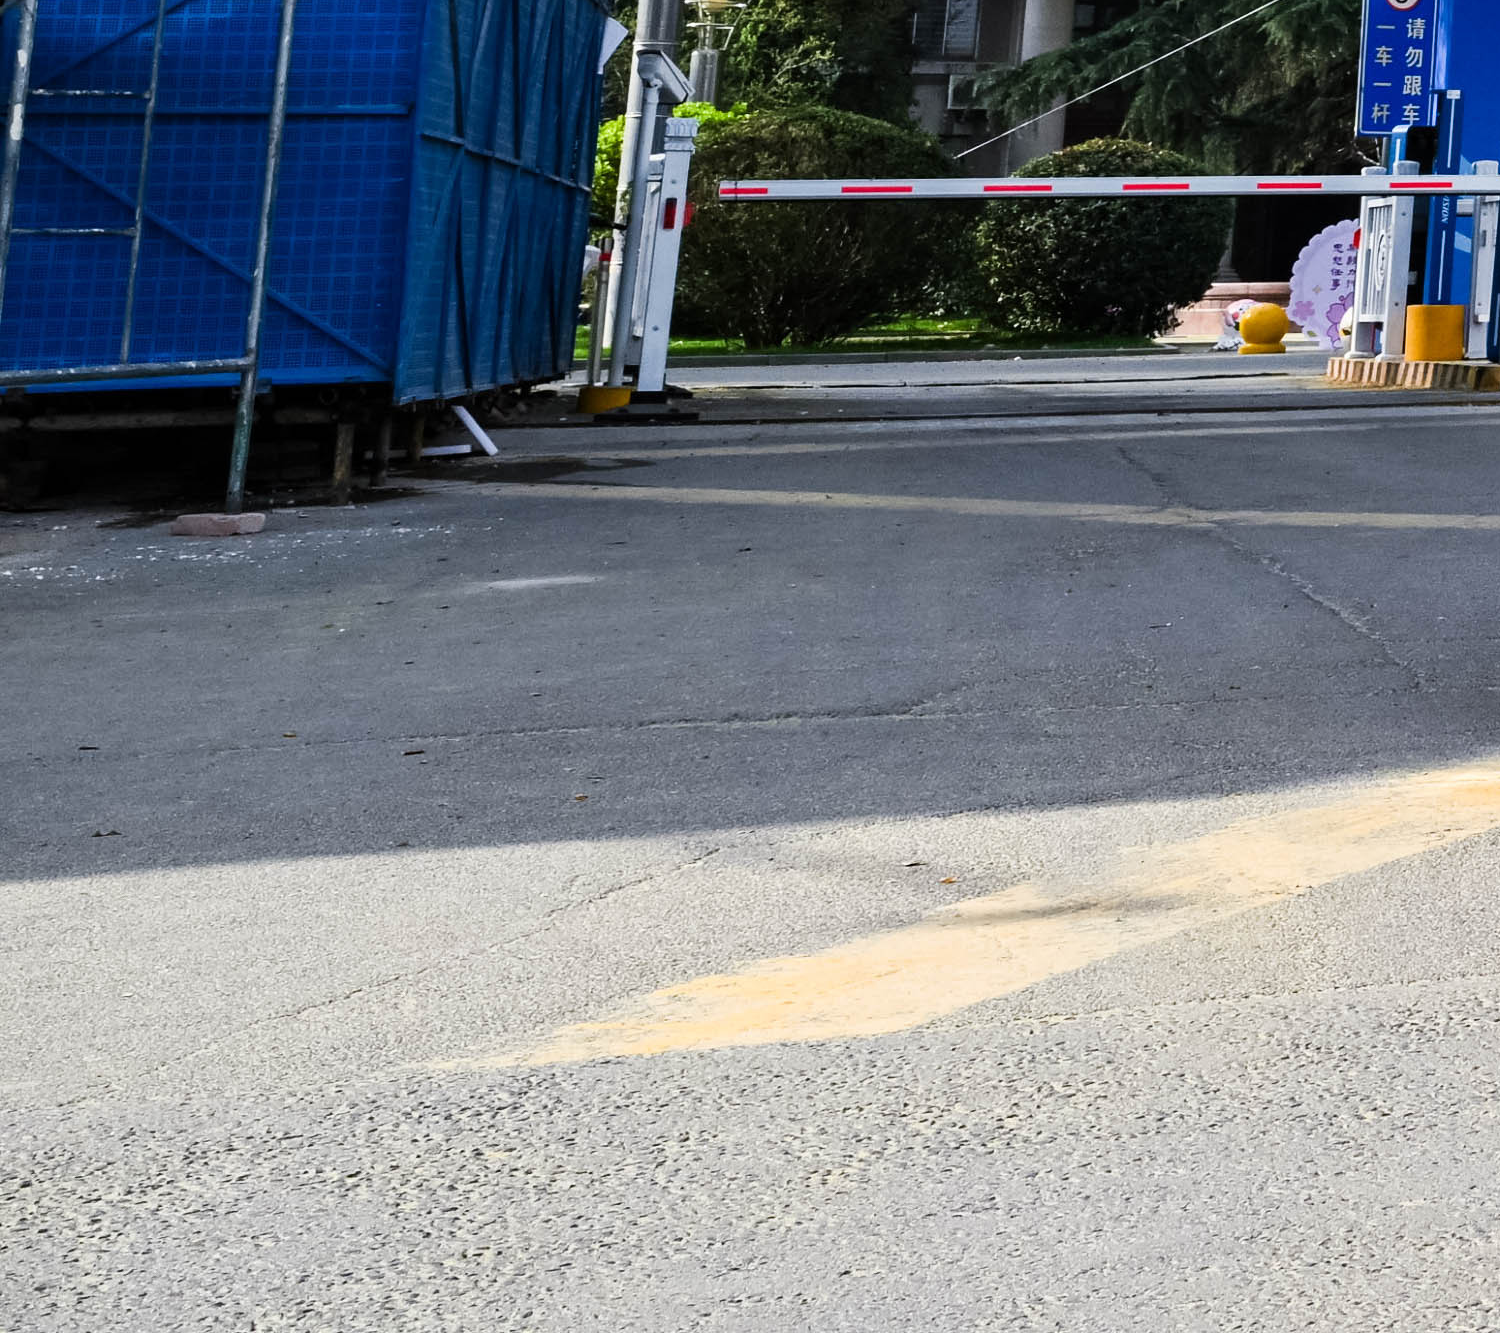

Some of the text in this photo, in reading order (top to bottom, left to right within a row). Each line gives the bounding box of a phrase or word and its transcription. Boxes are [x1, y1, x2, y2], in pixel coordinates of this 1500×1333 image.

[1371, 23, 1396, 125] 一车一杆
[1402, 18, 1426, 126] 请勿跟车
